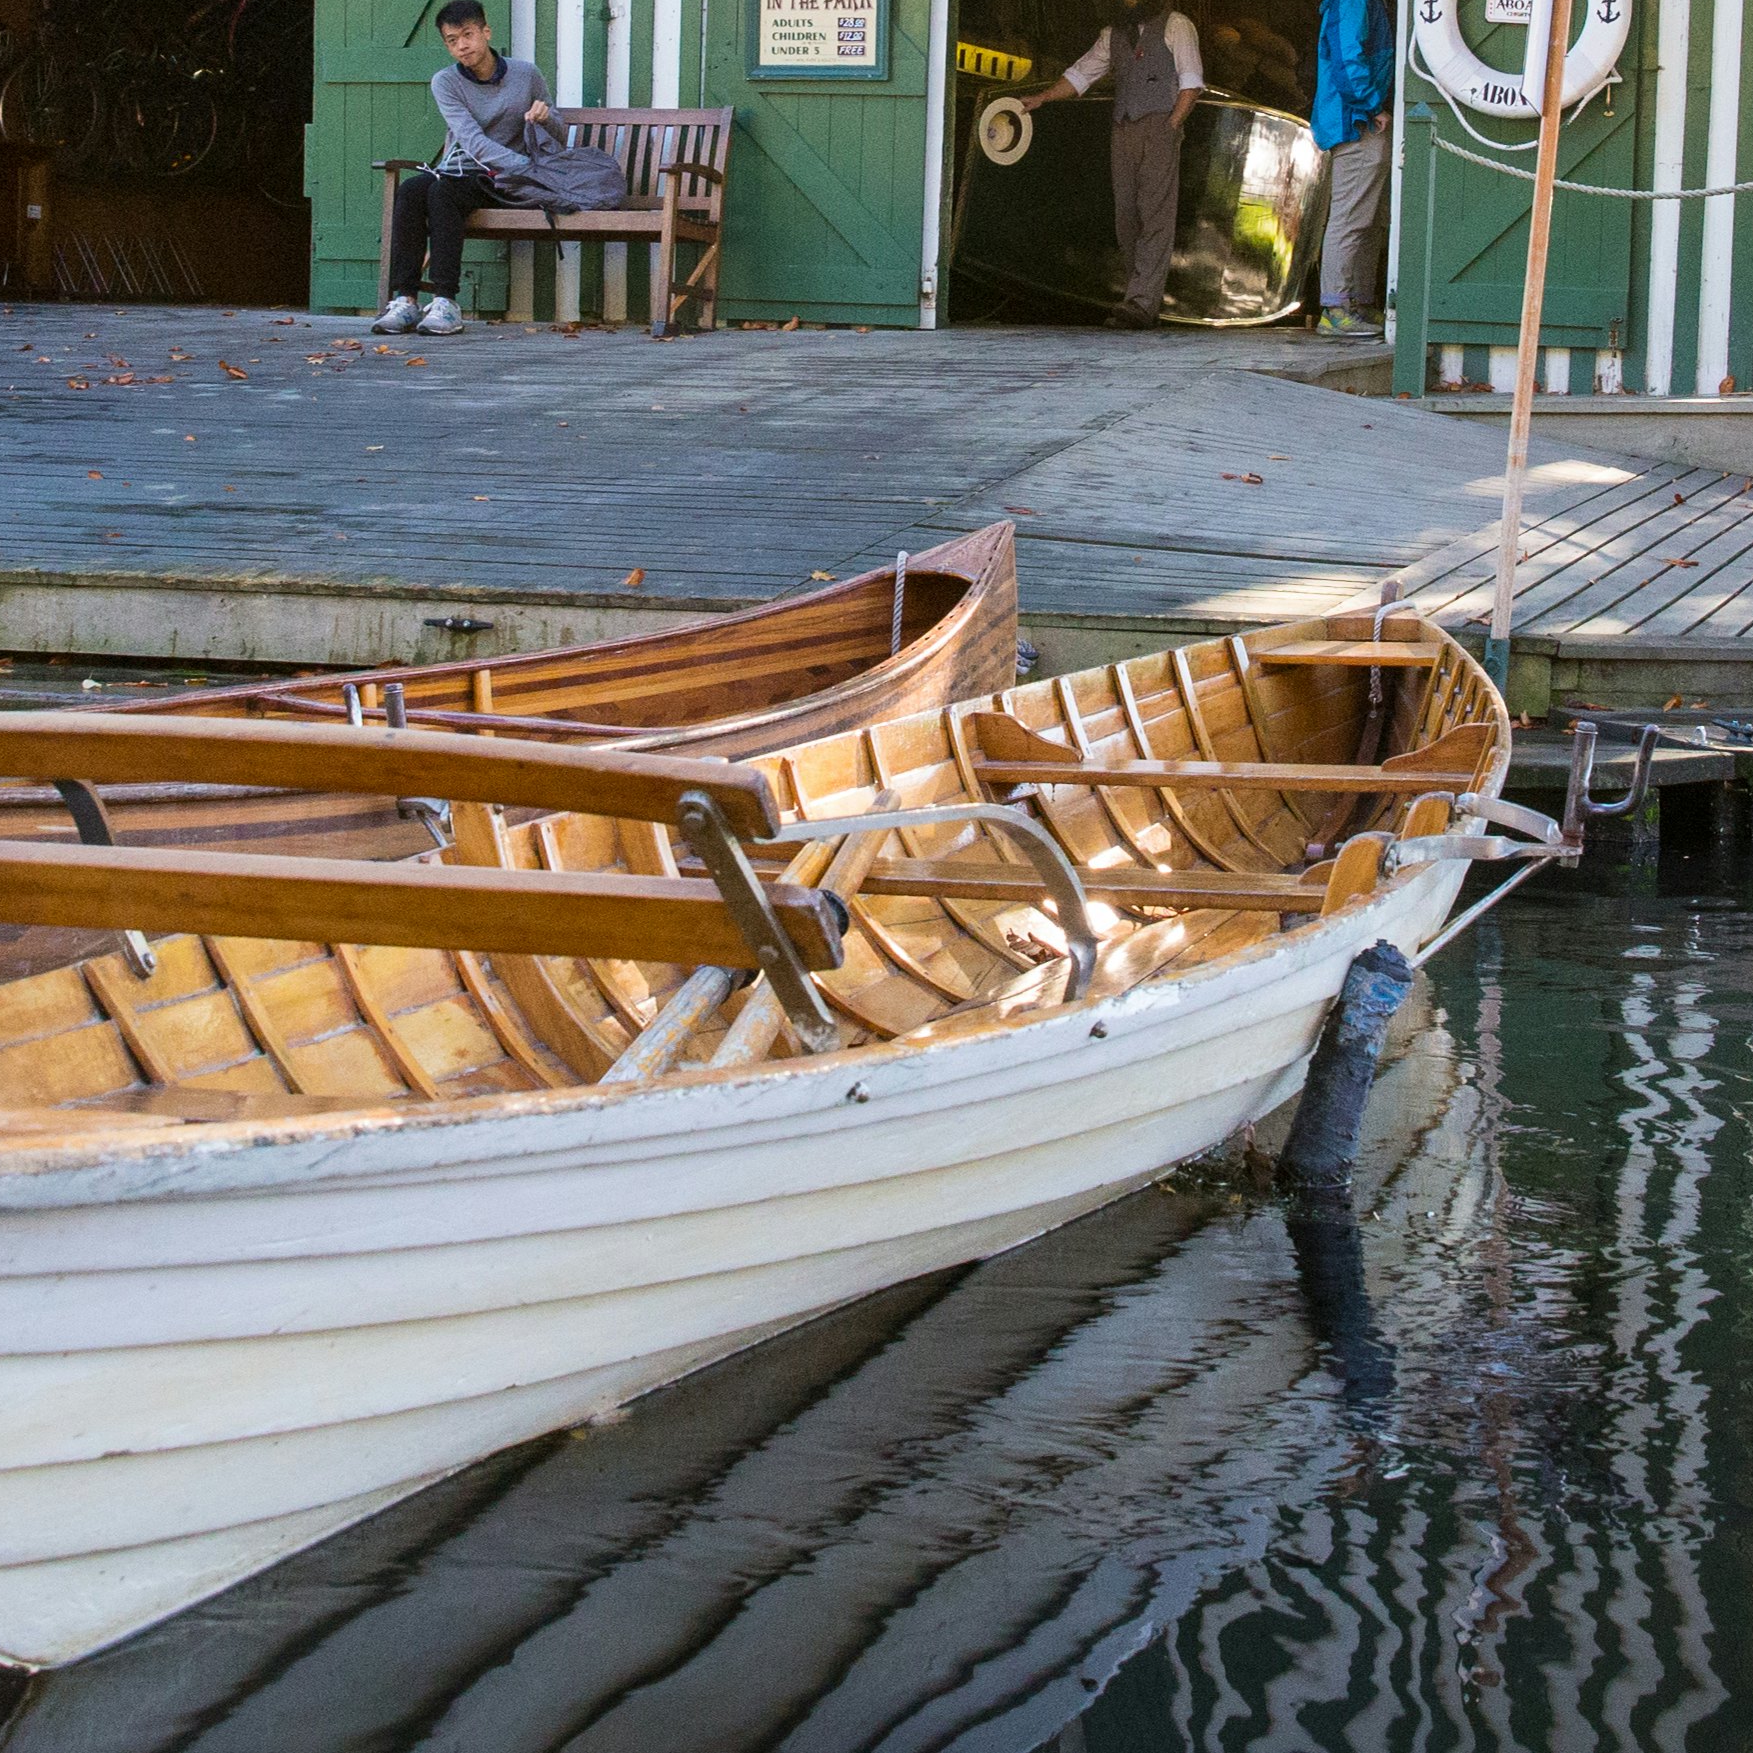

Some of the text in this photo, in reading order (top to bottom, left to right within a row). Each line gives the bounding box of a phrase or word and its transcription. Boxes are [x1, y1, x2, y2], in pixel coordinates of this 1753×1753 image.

[772, 19, 813, 28] ADULTS
[772, 32, 826, 41] CHILDREN
[772, 46, 864, 55] UNDER 5 FREE
